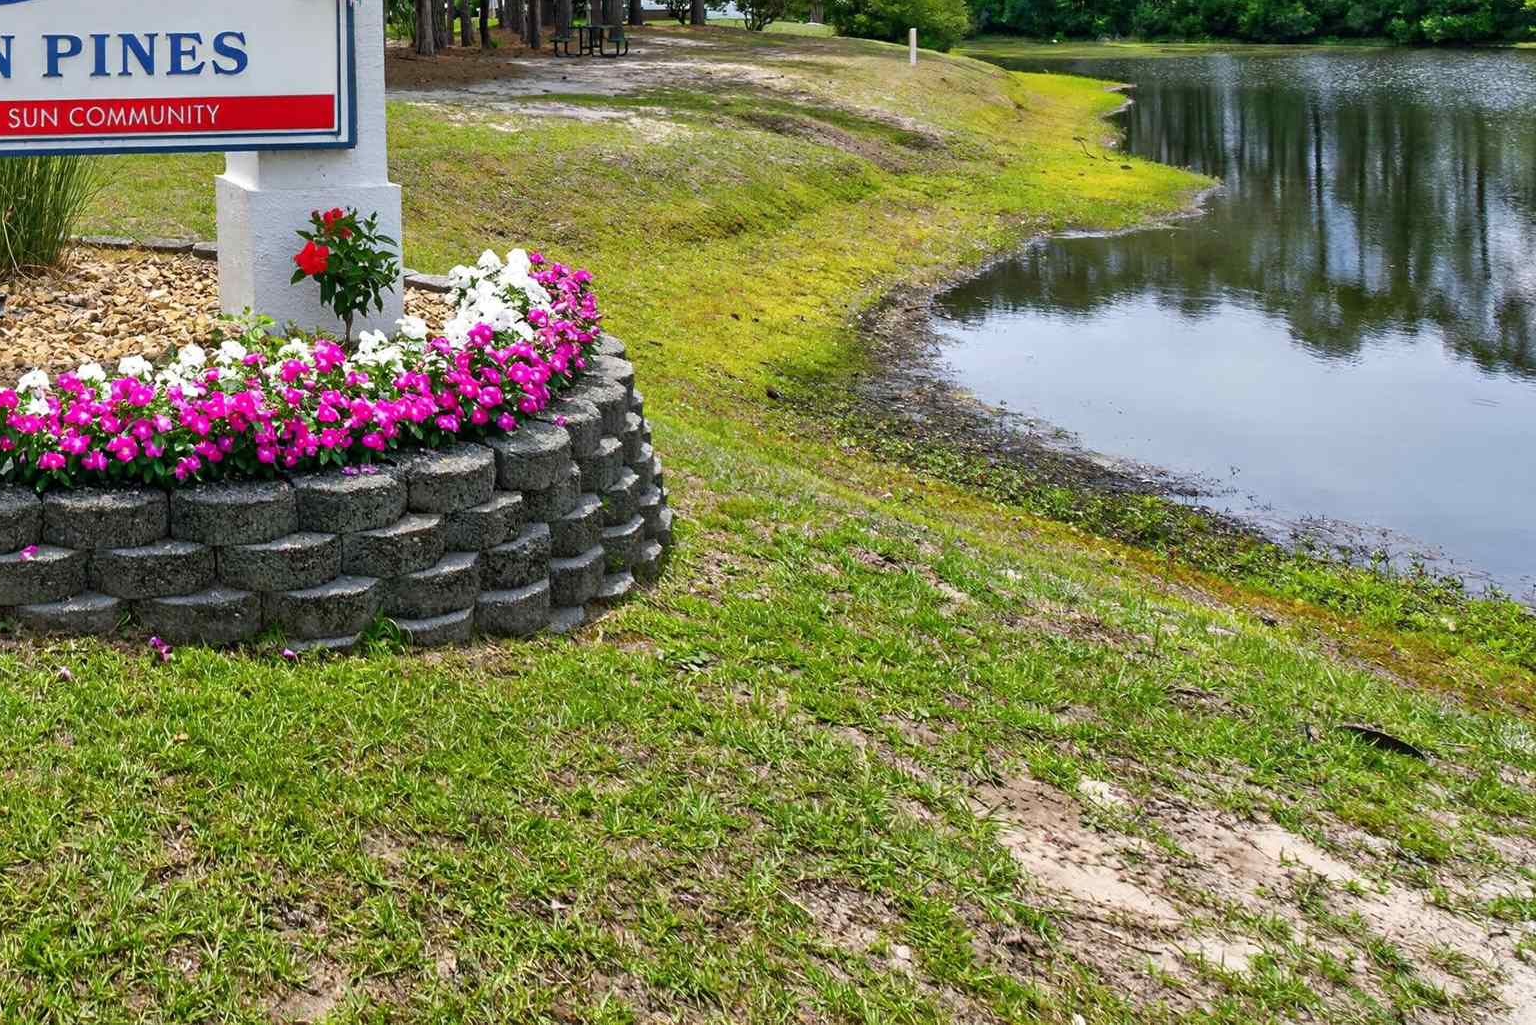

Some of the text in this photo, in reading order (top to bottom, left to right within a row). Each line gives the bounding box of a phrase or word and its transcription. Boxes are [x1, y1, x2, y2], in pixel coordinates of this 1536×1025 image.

[41, 31, 249, 79] PINES
[8, 107, 58, 129] SUN
[69, 104, 220, 127] COMMUNITY
